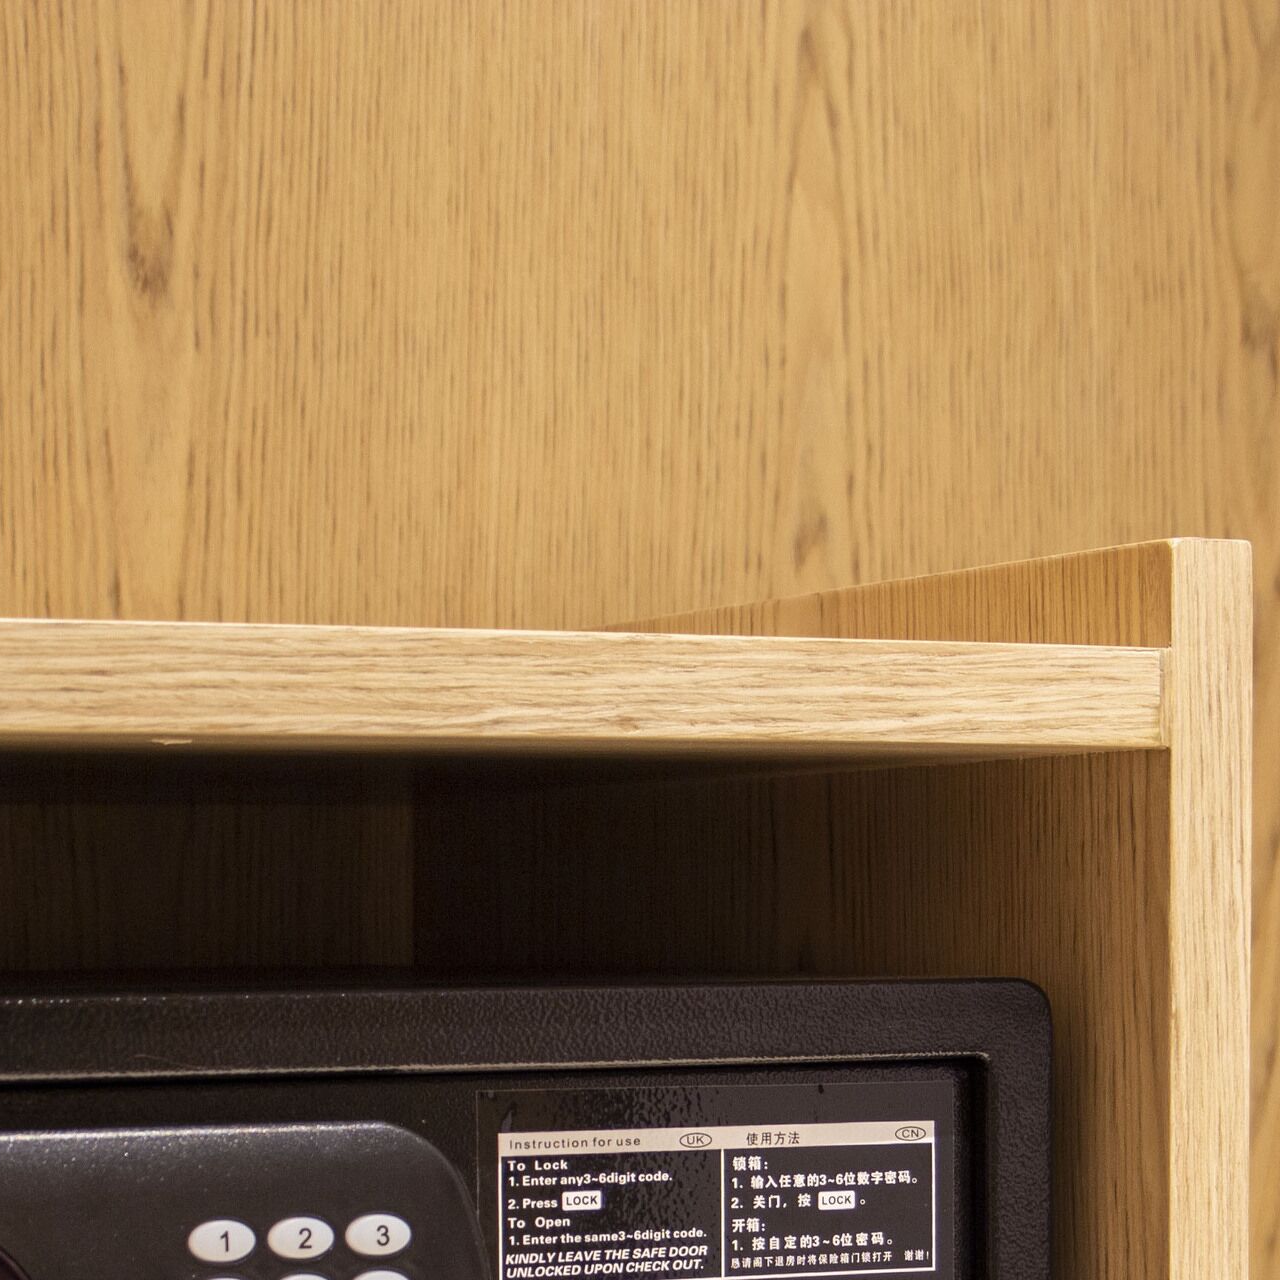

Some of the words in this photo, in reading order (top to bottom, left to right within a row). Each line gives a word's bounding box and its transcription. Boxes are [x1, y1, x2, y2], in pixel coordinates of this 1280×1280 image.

[686, 1136, 704, 1145] UK
[746, 1131, 800, 1146] 使用方法
[901, 1129, 919, 1138] CN
[509, 1138, 588, 1149] Instruction
[592, 1136, 612, 1147] for
[616, 1137, 640, 1146] use
[507, 1160, 526, 1171] To
[534, 1159, 568, 1170] Lock
[508, 1176, 519, 1186] 1.
[522, 1175, 557, 1186] Enter
[638, 1170, 672, 1182] code.
[508, 1199, 520, 1210] 2.
[522, 1198, 558, 1209] Press
[566, 1196, 598, 1206] LOCK
[822, 1196, 852, 1205] LOCK
[507, 1217, 525, 1229] To
[534, 1216, 570, 1229] Open
[220, 1231, 229, 1252] 1
[298, 1228, 312, 1249] 2
[376, 1225, 390, 1246] 3
[508, 1235, 519, 1245] 1.
[522, 1234, 558, 1245] Enter
[560, 1232, 582, 1243] the
[672, 1226, 707, 1238] code.
[506, 1253, 556, 1266] KINDLY
[558, 1250, 601, 1262] LEAVE
[604, 1248, 630, 1260] THE
[632, 1246, 667, 1259] SAFE
[668, 1244, 708, 1257] DOOR
[506, 1264, 581, 1278] UNLOCKED
[584, 1262, 624, 1274] UPON
[625, 1260, 670, 1273] CHECK
[672, 1258, 704, 1270] OUT.
